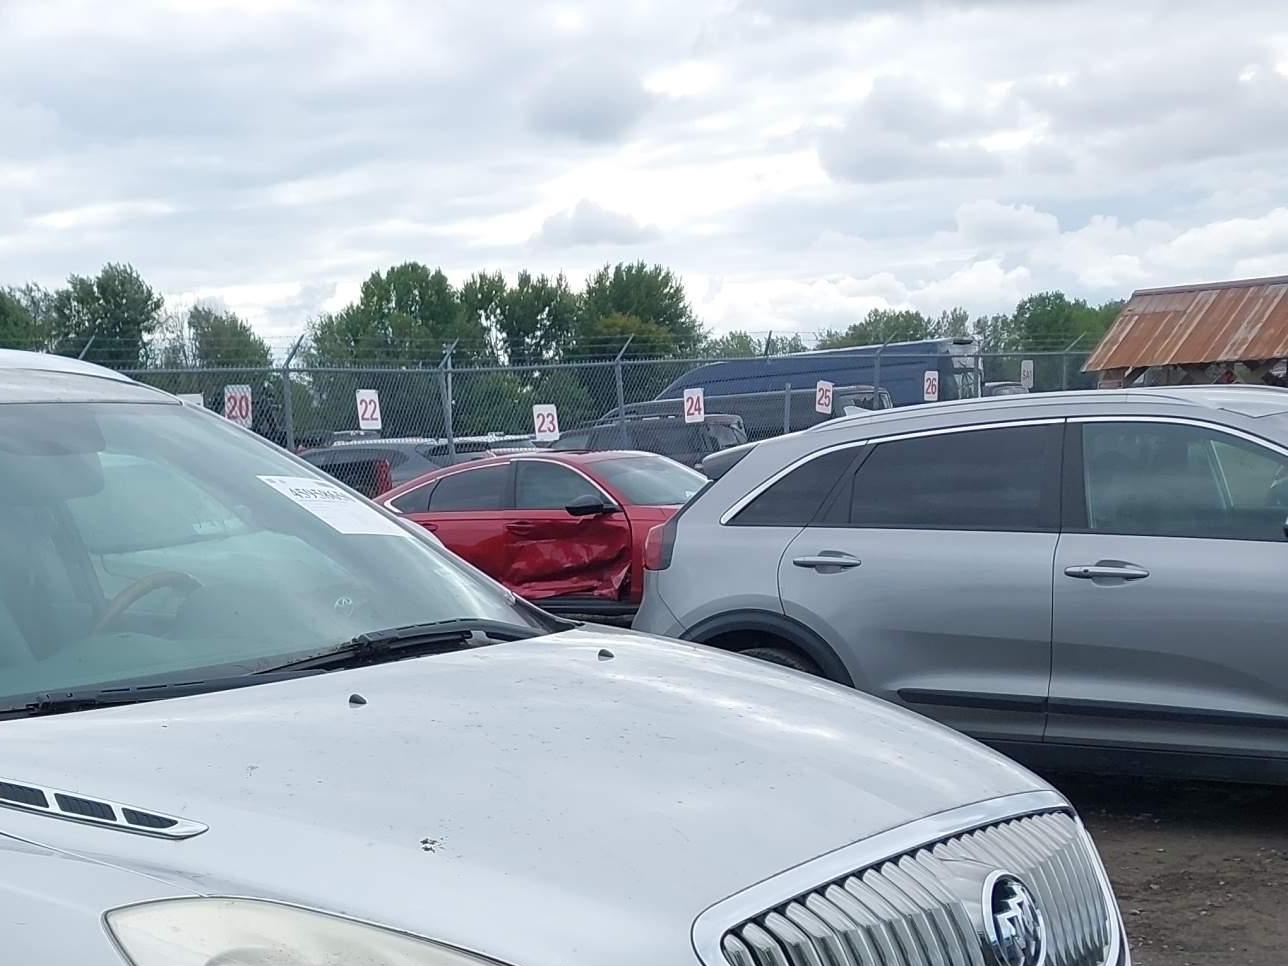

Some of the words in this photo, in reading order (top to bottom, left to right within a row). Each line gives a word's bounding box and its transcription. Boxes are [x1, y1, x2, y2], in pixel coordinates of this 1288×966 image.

[925, 377, 937, 395] 26
[685, 396, 702, 417] 24
[818, 387, 831, 407] 25
[227, 395, 250, 420] 20
[359, 399, 378, 421] 22
[536, 413, 556, 433] 23
